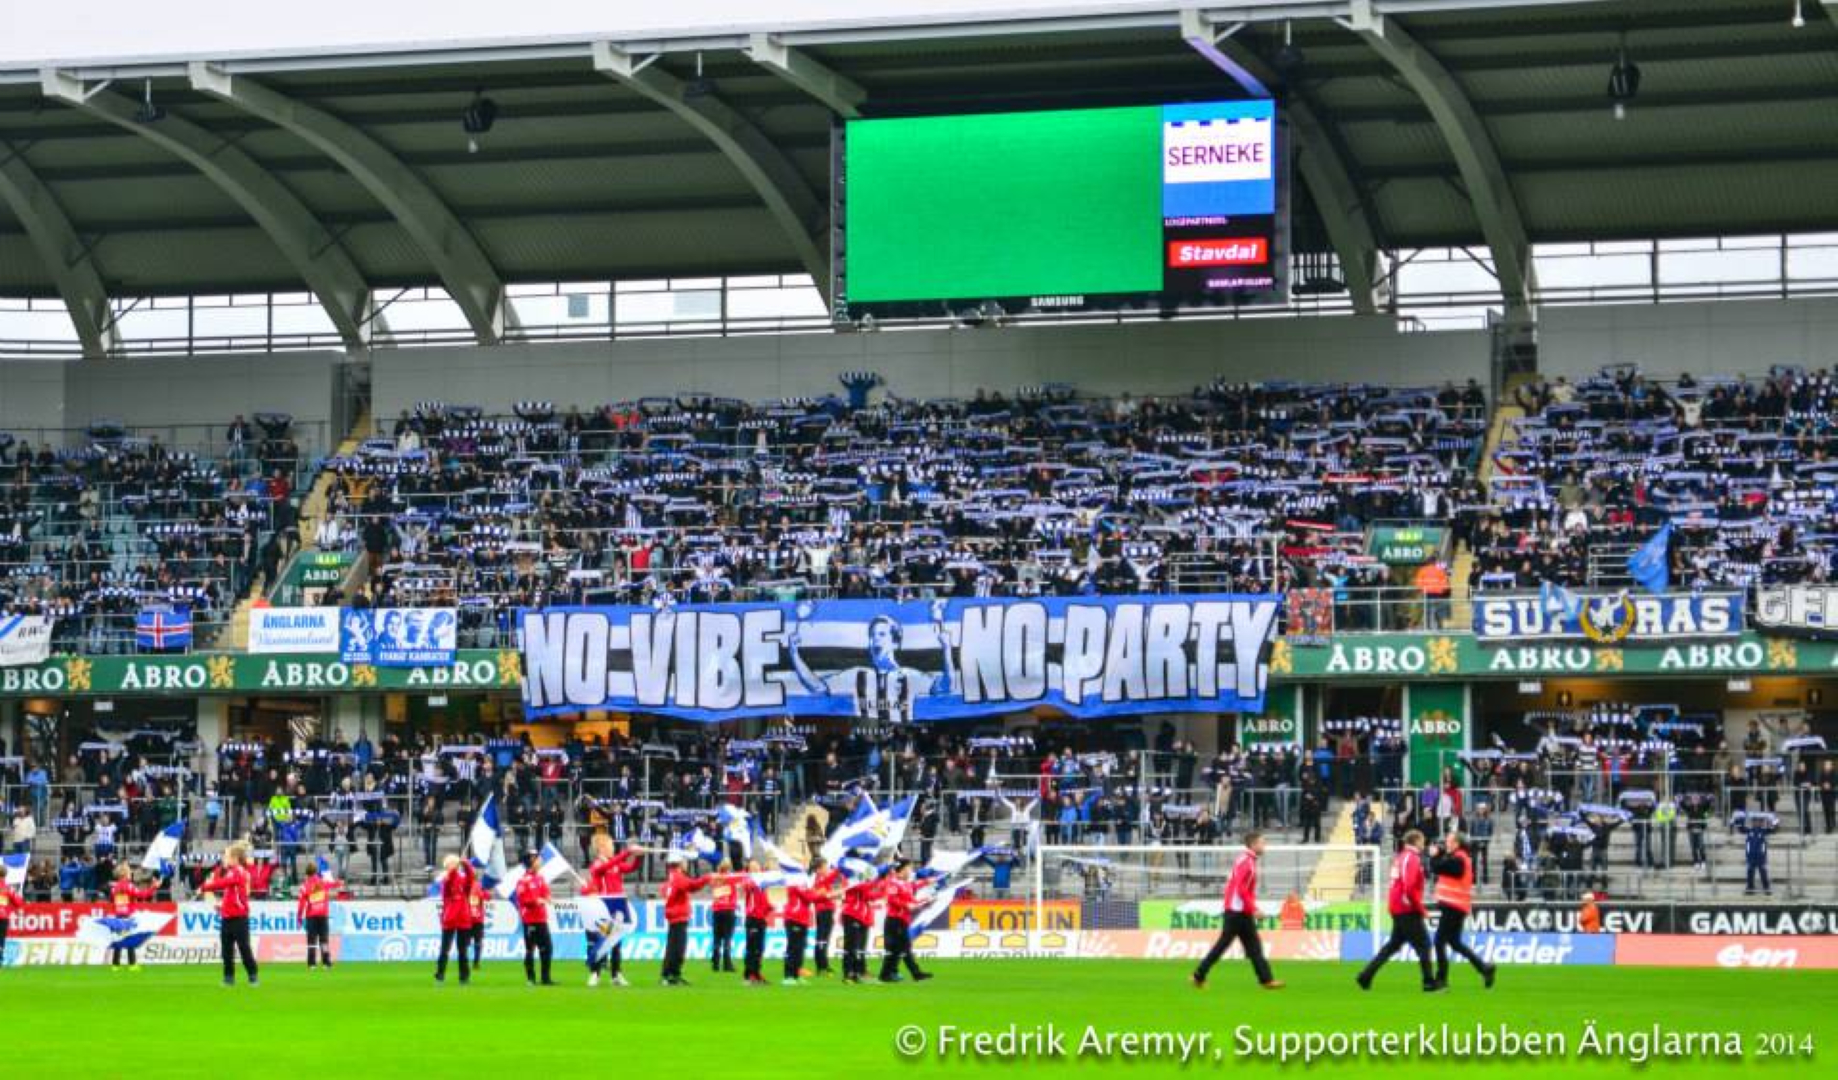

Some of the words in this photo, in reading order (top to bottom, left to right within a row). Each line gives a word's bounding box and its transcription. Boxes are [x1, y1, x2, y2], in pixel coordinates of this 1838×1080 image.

[1167, 142, 1264, 168] SERNEKE
[524, 611, 609, 711] NO
[629, 608, 785, 711] VIBE
[959, 602, 1047, 703] NO
[1064, 601, 1276, 705] PARTY
[1325, 644, 1427, 673] ÅBRO
[121, 662, 205, 690] ÅBRO
[261, 659, 348, 686] ÅBRO
[351, 911, 405, 931] Vent
[1690, 911, 1798, 935] GAMLA
